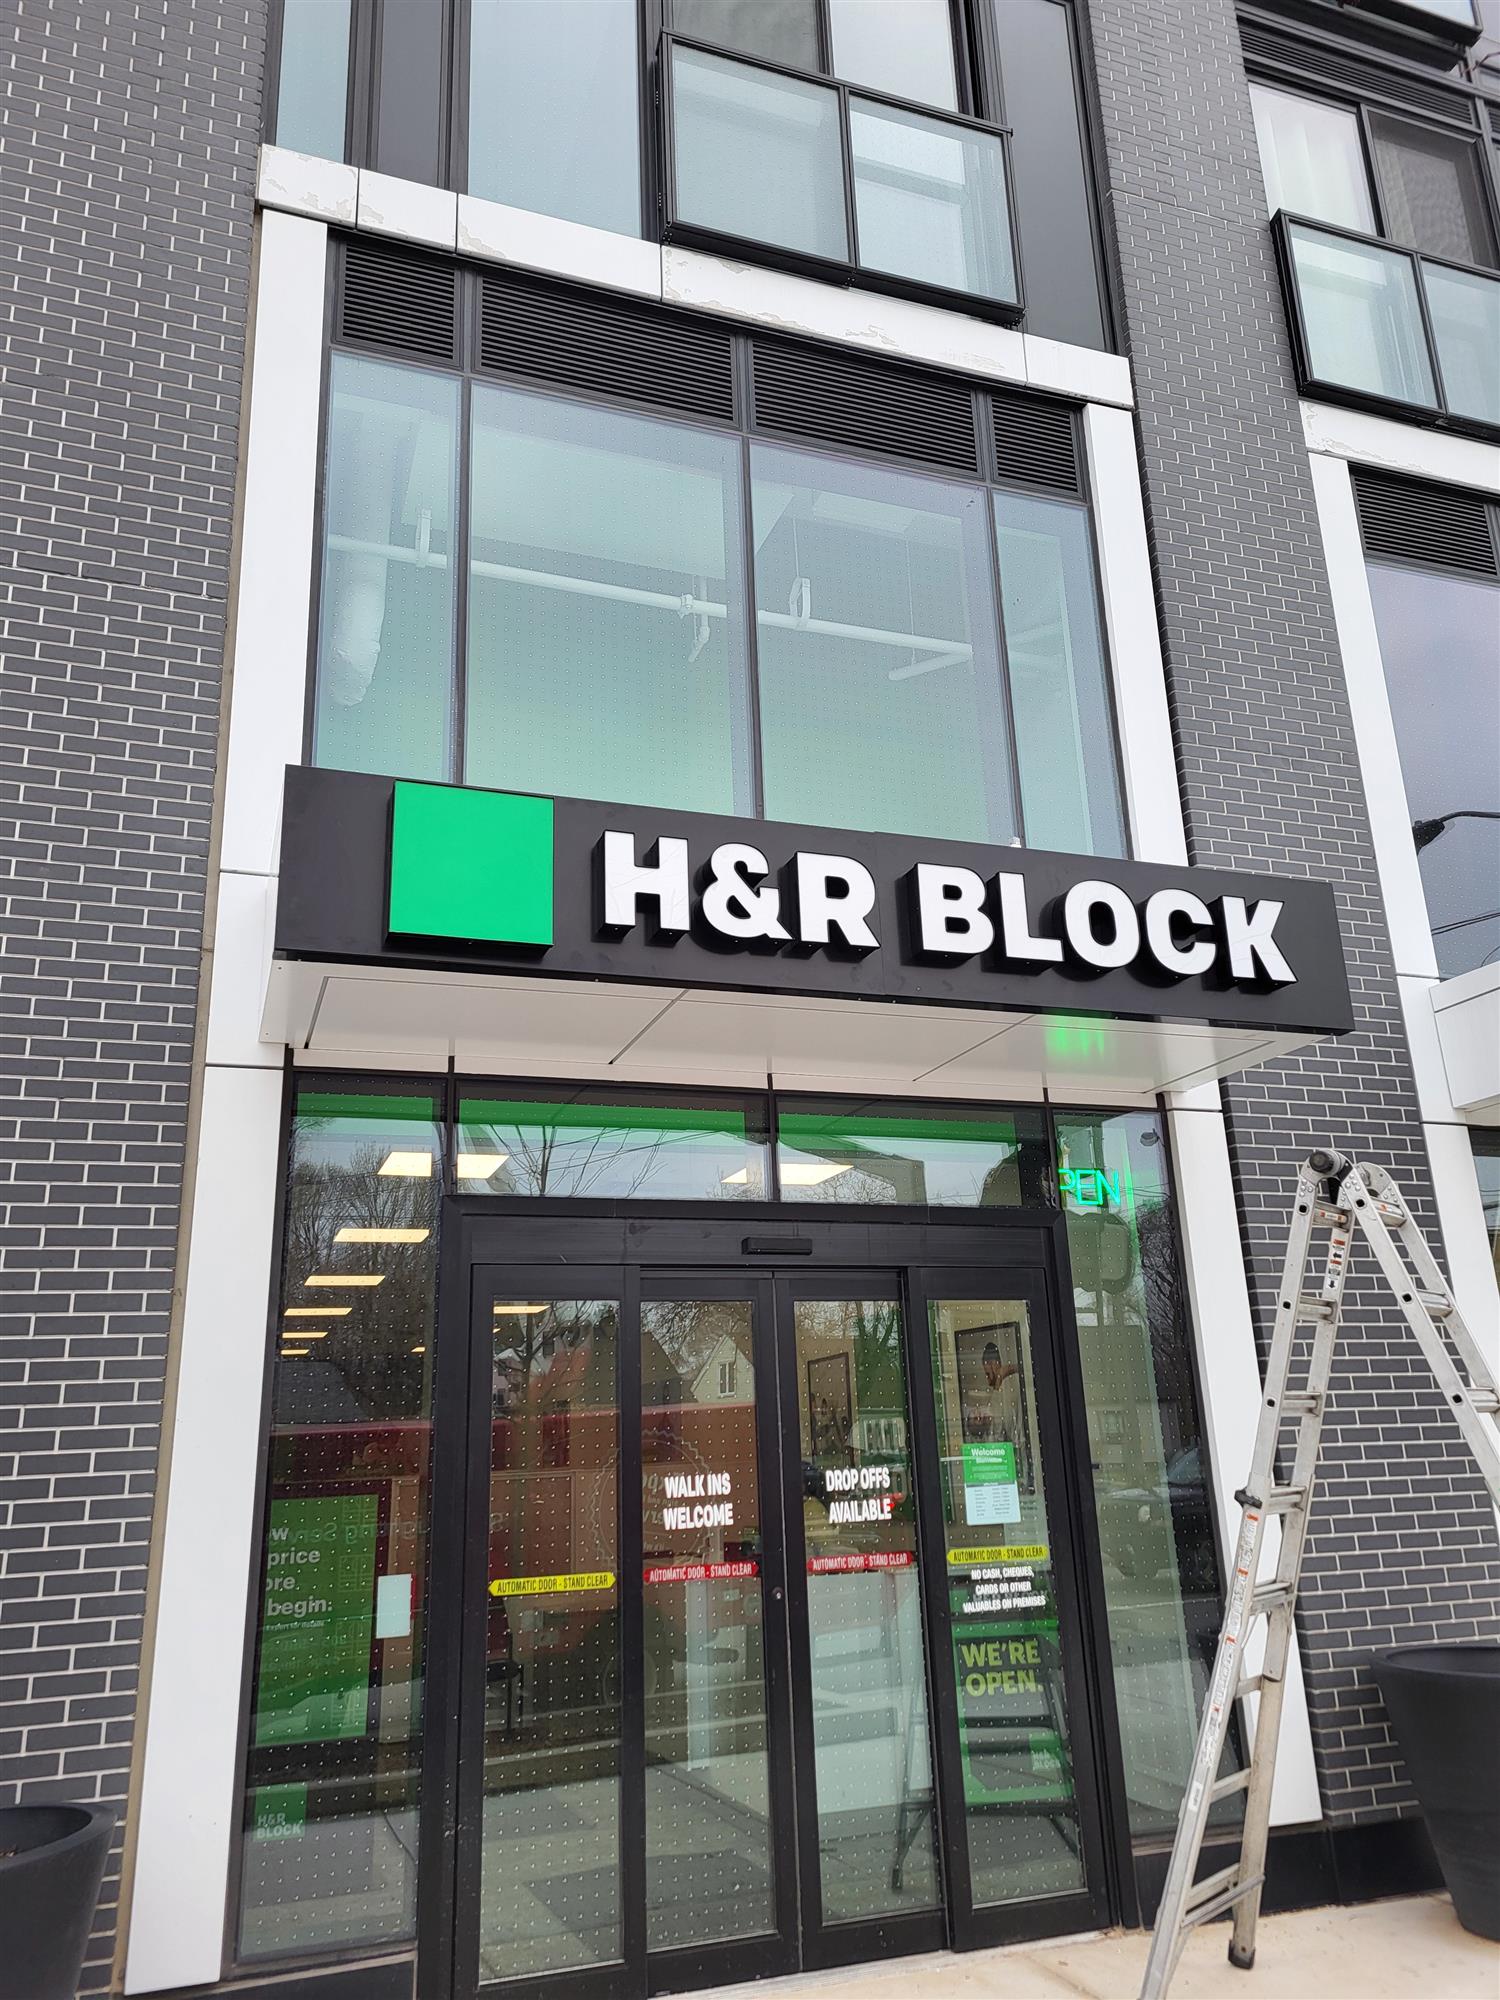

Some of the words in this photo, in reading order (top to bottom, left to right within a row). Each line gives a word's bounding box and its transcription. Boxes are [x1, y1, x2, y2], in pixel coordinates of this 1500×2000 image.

[603, 829, 880, 949] H&R
[917, 862, 1297, 982] BLOCK
[971, 1447, 1005, 1456] Welcome
[664, 1474, 706, 1499] WALK
[707, 1472, 731, 1496] INS
[826, 1469, 859, 1492] DROP
[860, 1467, 890, 1489] OFFS
[663, 1503, 734, 1530] WELCOME
[829, 1498, 892, 1524] AVAILABLE
[269, 1527, 289, 1541] w
[267, 1547, 321, 1569] price
[812, 1557, 847, 1570] AUTOMATIC
[847, 1556, 865, 1568] DOOR
[869, 1554, 888, 1566] STAND
[889, 1553, 907, 1565] CLEAR
[954, 1549, 986, 1561] AUTOMATIC
[987, 1549, 1002, 1560] DOOR
[1007, 1548, 1025, 1559] STAND
[1025, 1547, 1044, 1558] CLEAR
[650, 1566, 687, 1581] AUTOMATIC
[687, 1565, 705, 1578] DOOR
[710, 1564, 731, 1577] STAND
[731, 1563, 752, 1575] CLEAR
[971, 1569, 981, 1580] NO
[982, 1567, 1002, 1580] CASH,
[497, 1579, 537, 1593] AUTOMATIC
[538, 1579, 557, 1591] DOOR
[563, 1576, 584, 1589] STAND
[587, 1574, 608, 1587] CLEAR
[975, 1583, 999, 1595] CARDS
[1000, 1583, 1009, 1593] OR
[1010, 1581, 1031, 1592] OTHER
[962, 1600, 1001, 1613] VALUABLES
[1002, 1598, 1012, 1609] ON
[1013, 1595, 1046, 1608] PREMISES
[961, 1640, 1041, 1668] WE'RE
[965, 1669, 1044, 1697] OPEN.
[257, 1813, 286, 1826] H&R
[256, 1823, 301, 1839] BLOCK
